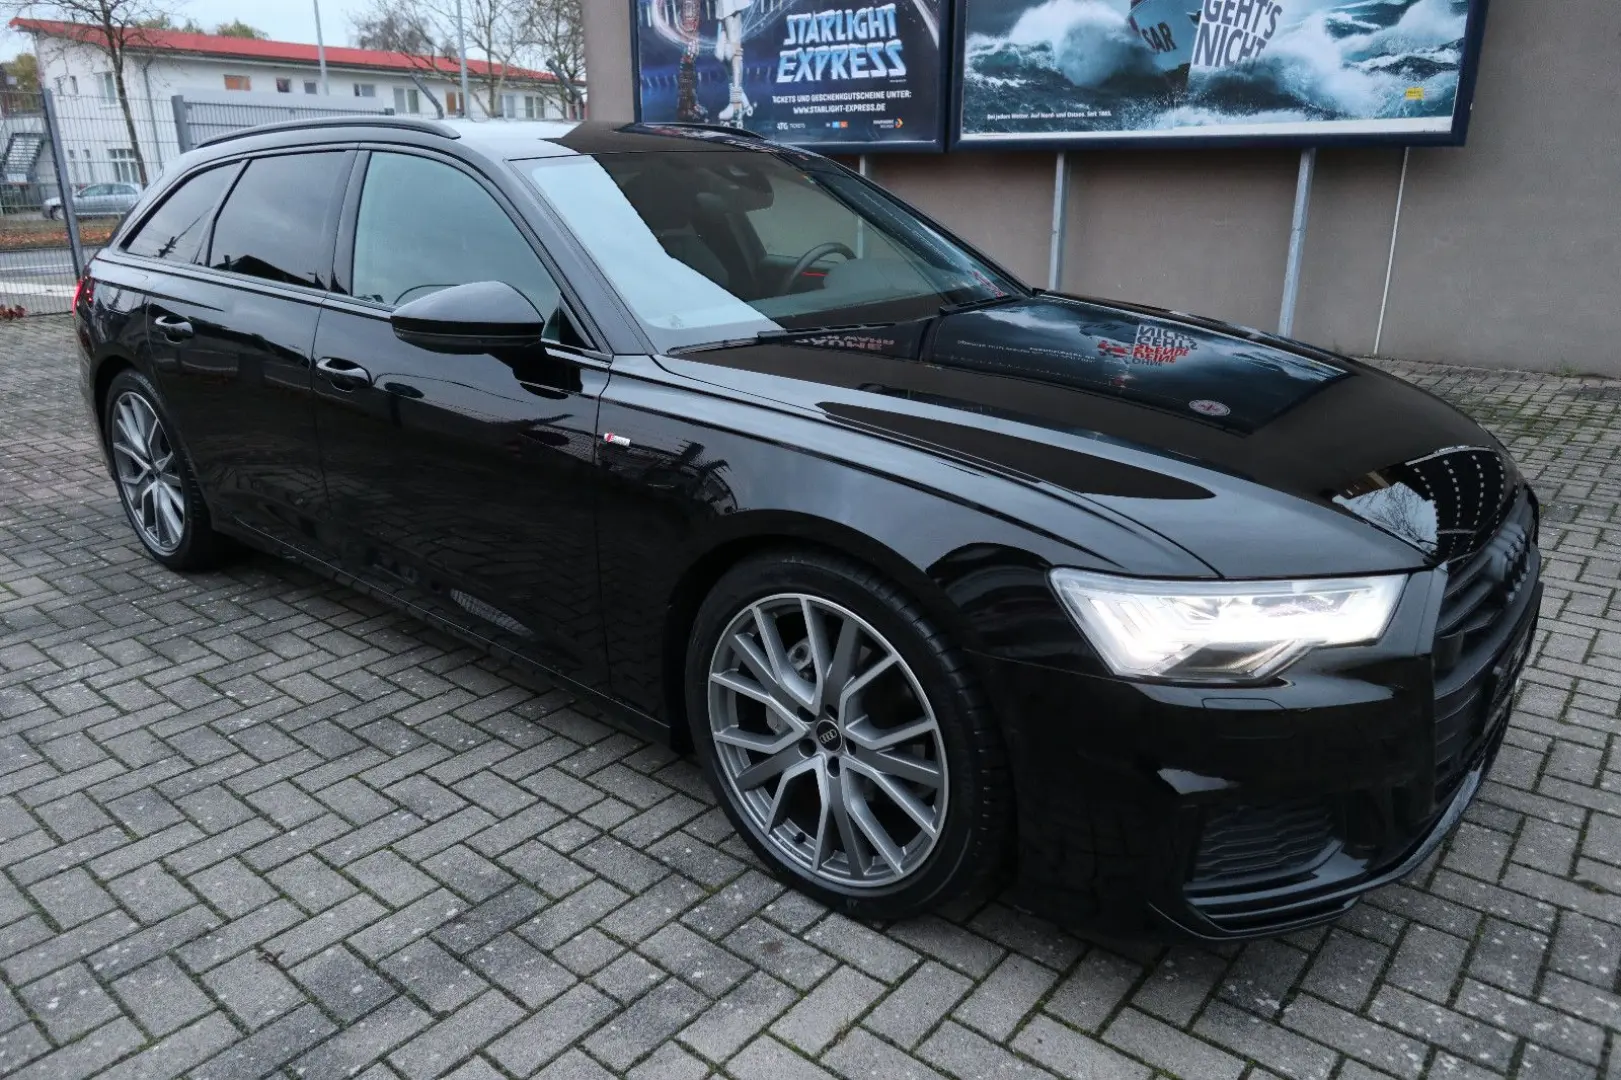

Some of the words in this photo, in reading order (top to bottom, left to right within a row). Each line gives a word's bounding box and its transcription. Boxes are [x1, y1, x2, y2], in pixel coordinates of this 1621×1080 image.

[783, 3, 897, 46] STARLIGHT
[1141, 22, 1177, 54] SAR
[1203, 0, 1282, 40] GEHT'S
[776, 39, 907, 83] EXPRESS
[772, 95, 796, 104] TICKETS
[797, 94, 810, 102] UND
[811, 91, 885, 102] GESCHENKGUTSCHEINE
[886, 90, 912, 99] UNTER:
